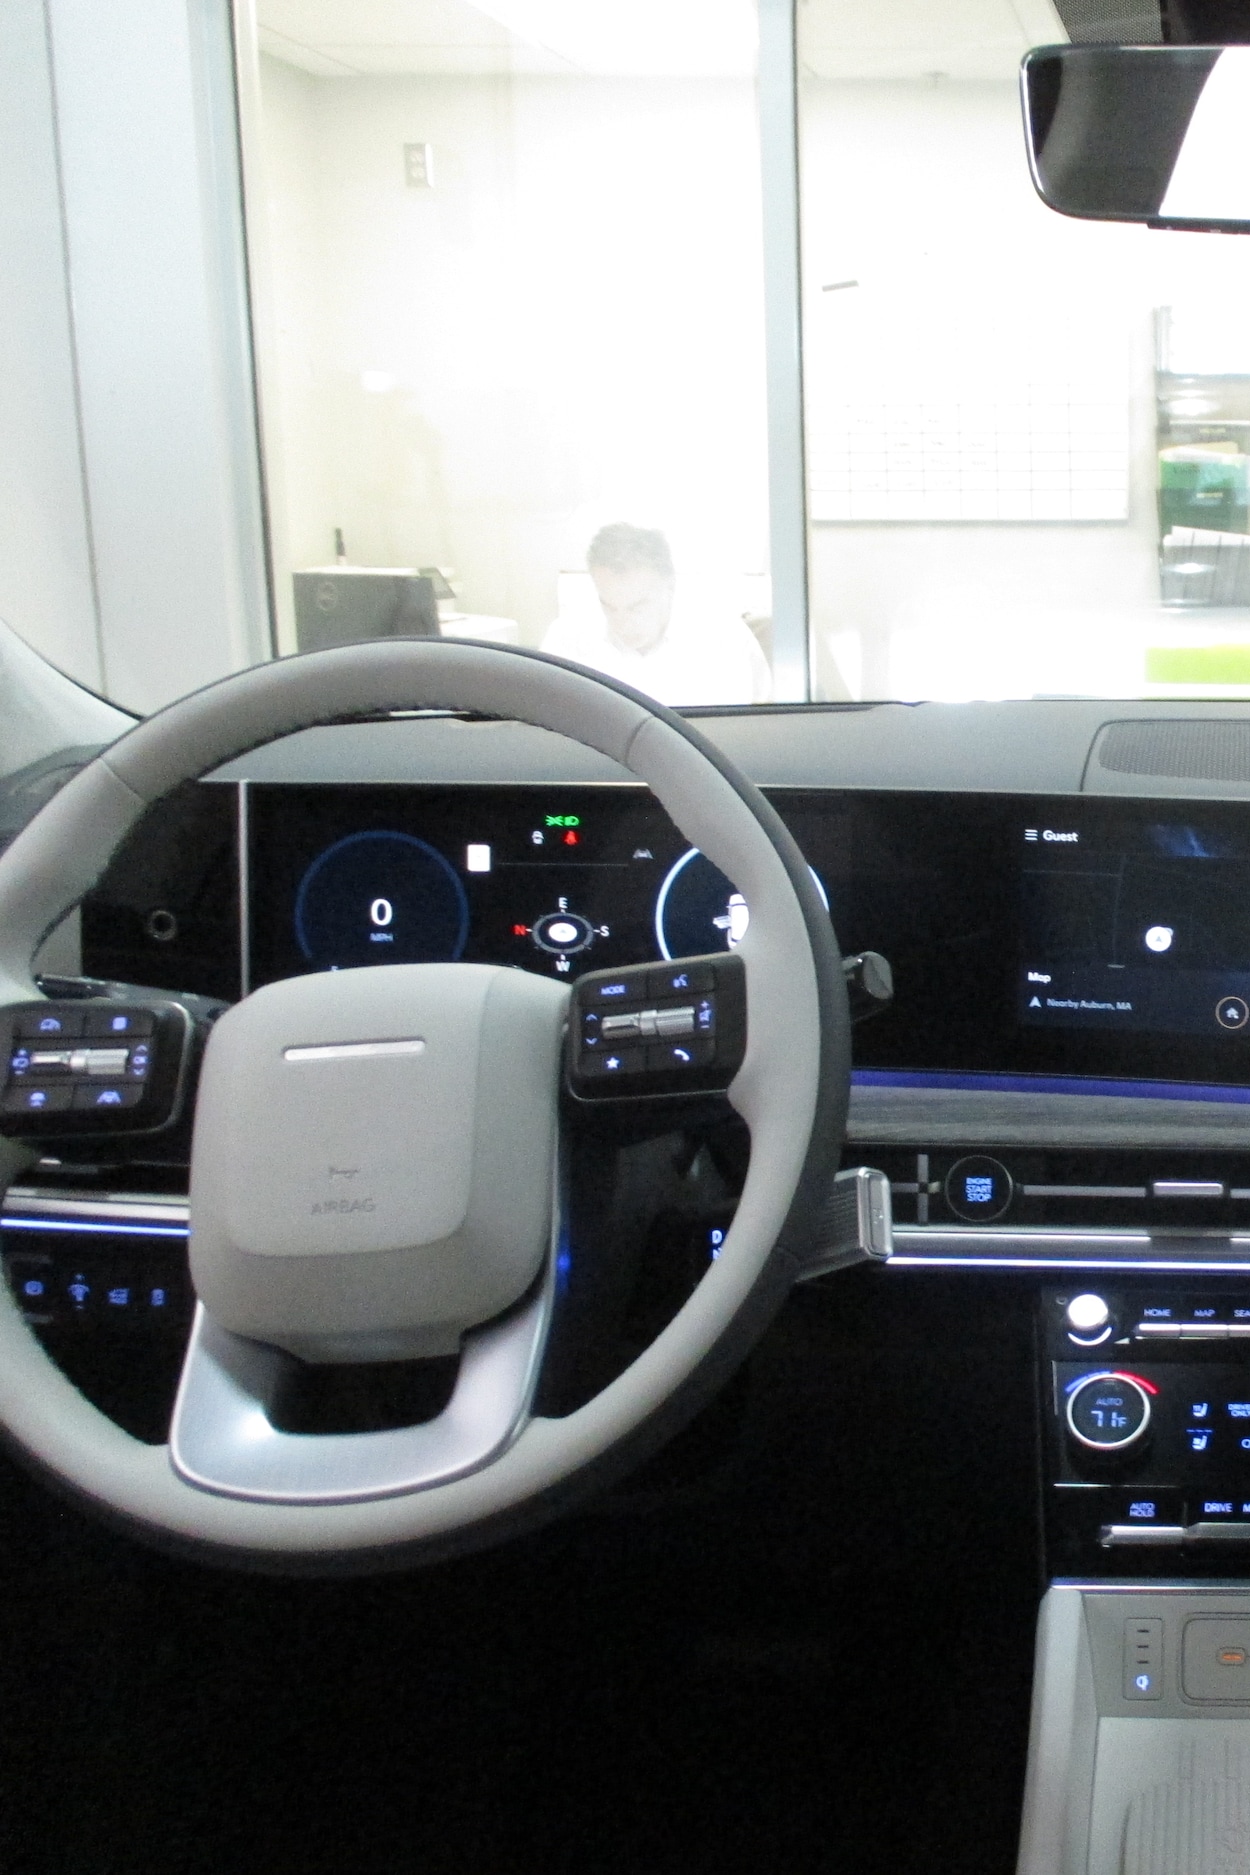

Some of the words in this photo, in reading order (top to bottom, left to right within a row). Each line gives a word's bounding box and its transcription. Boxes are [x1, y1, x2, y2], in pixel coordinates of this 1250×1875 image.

[1043, 831, 1078, 843] Guest
[558, 897, 568, 909] E
[371, 898, 393, 926] 0
[513, 924, 526, 936] N
[600, 925, 609, 936] S
[369, 933, 394, 943] MPH
[555, 960, 571, 972] W
[1028, 972, 1051, 984] Map
[601, 984, 626, 996] MODE
[1047, 998, 1079, 1010] Nearby
[1116, 1001, 1132, 1011] MA
[965, 1185, 993, 1194] START
[967, 1193, 992, 1202] STOP
[711, 1229, 723, 1244] D
[1143, 1308, 1172, 1317] HOME
[1194, 1309, 1215, 1318] MAP
[1096, 1398, 1124, 1406] AUTO
[1129, 1502, 1155, 1510] AUTO
[1203, 1502, 1233, 1513] DRIVE
[1129, 1509, 1155, 1518] HOLD
